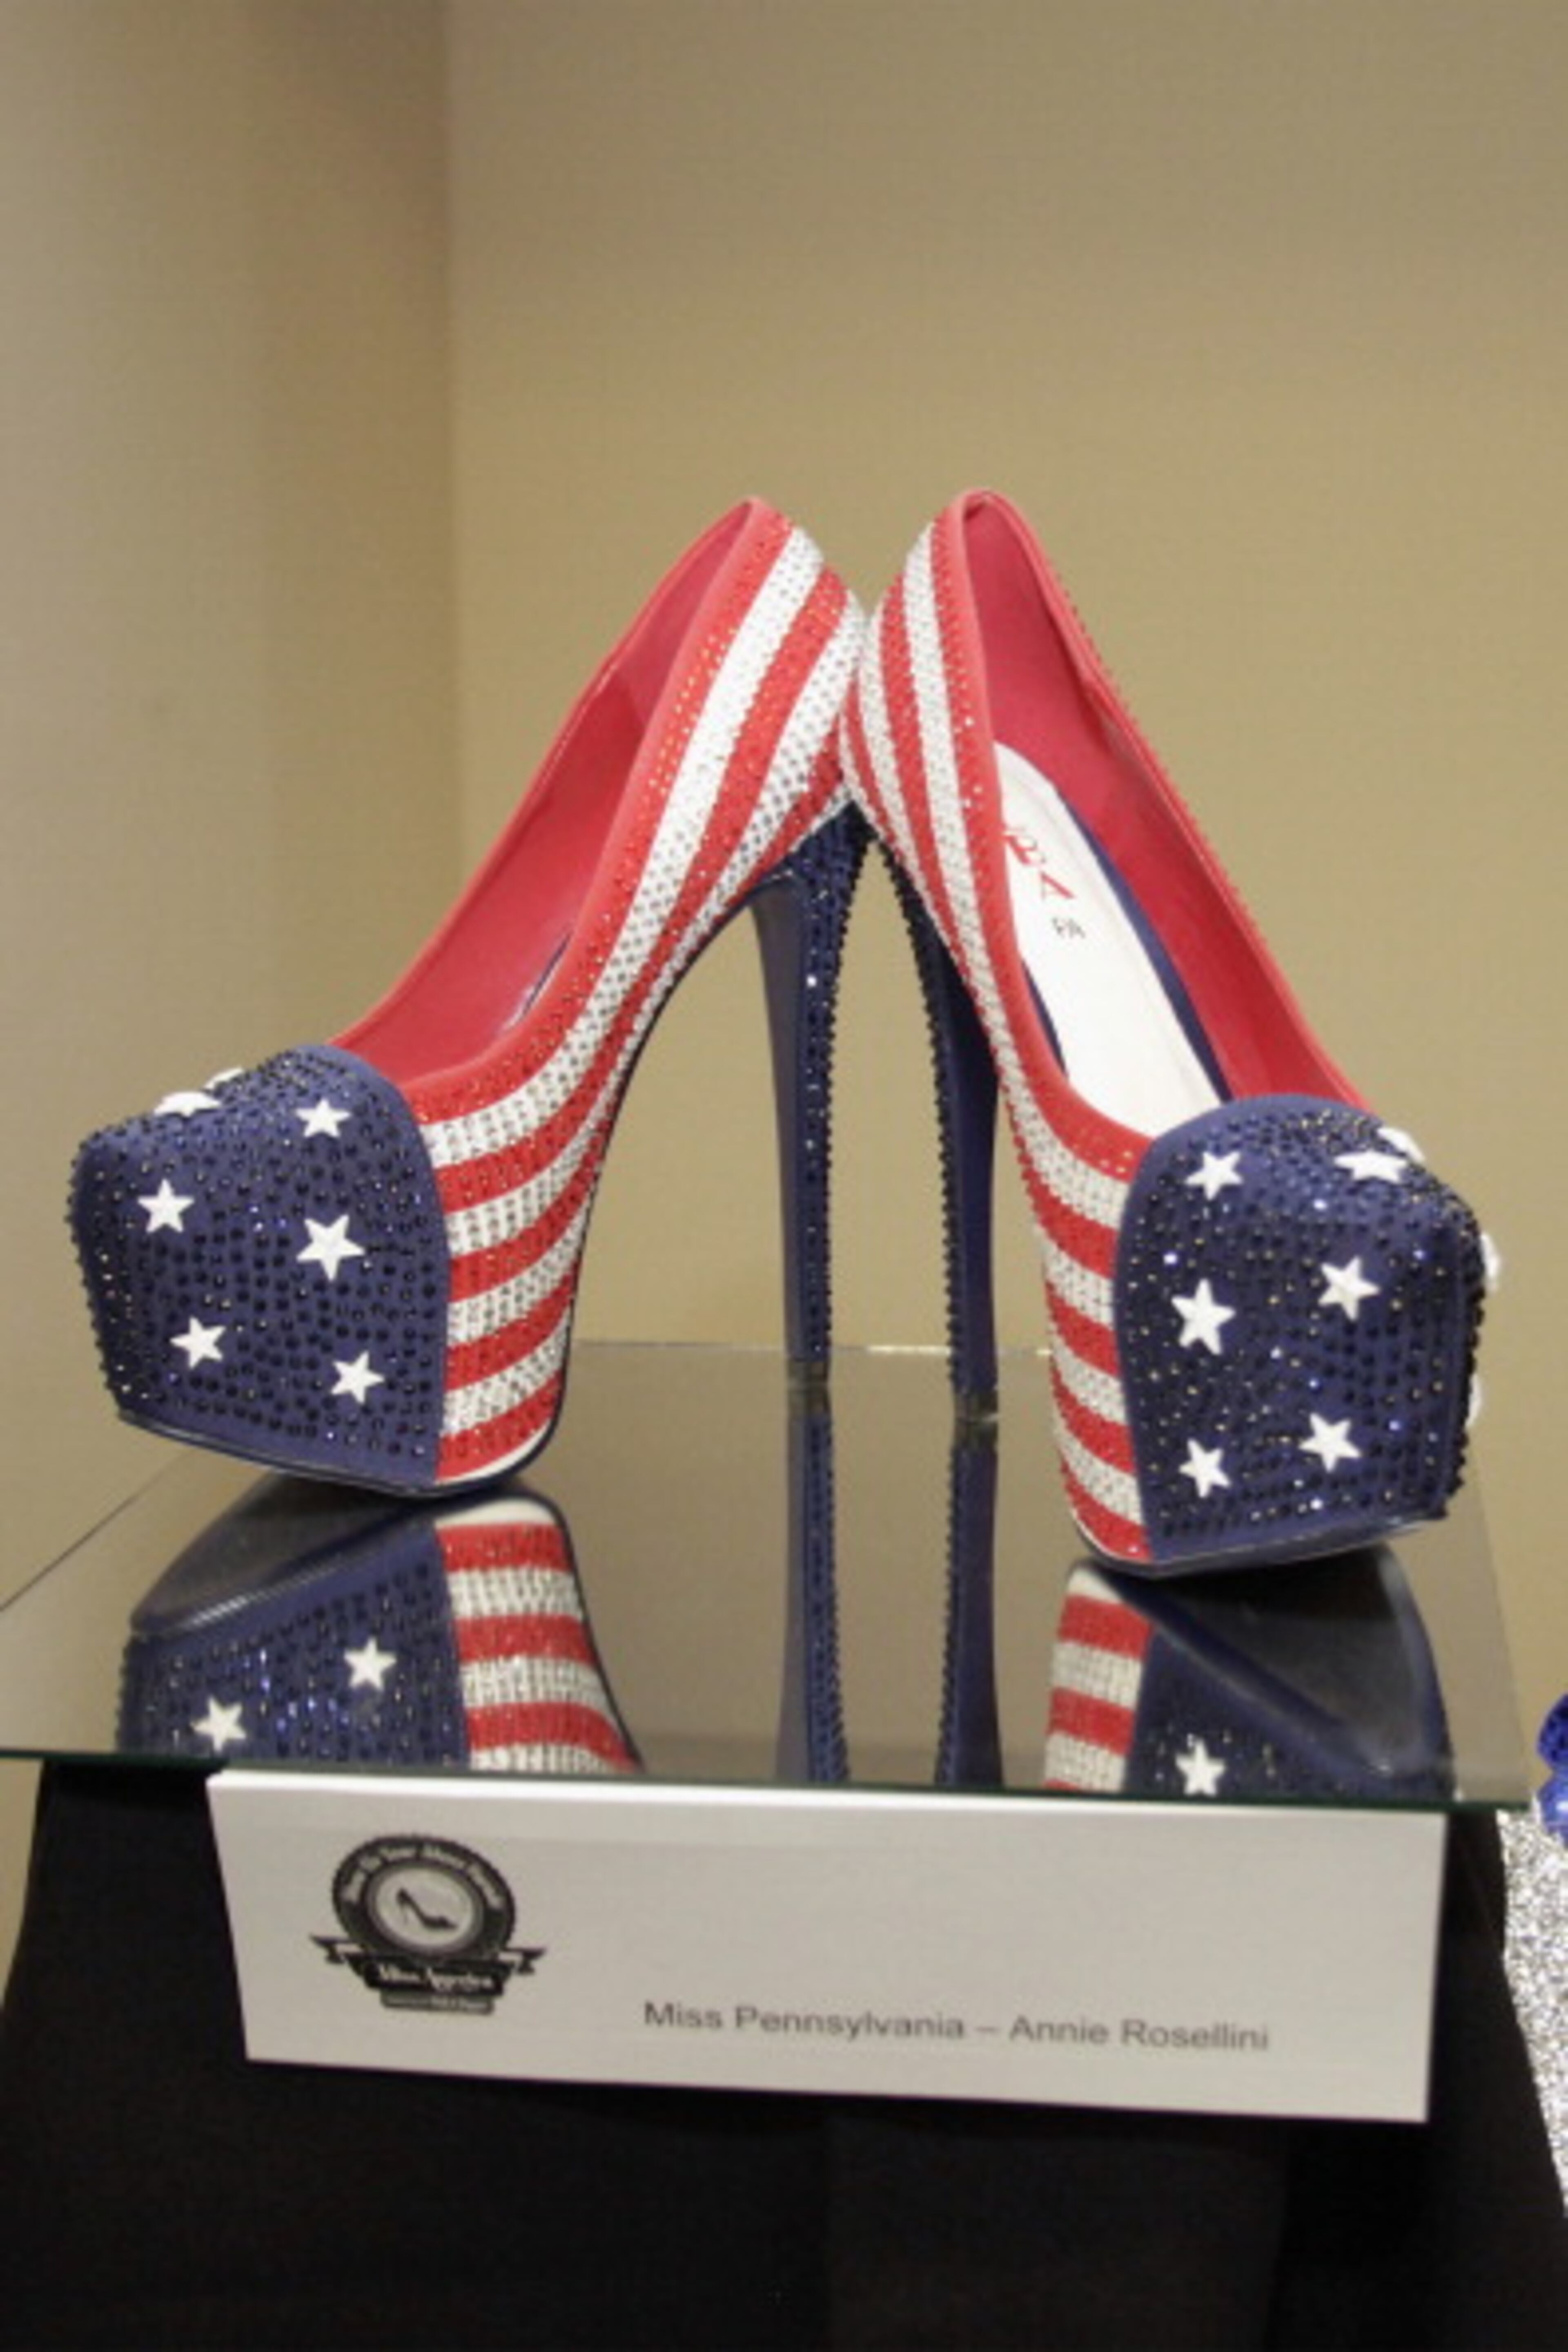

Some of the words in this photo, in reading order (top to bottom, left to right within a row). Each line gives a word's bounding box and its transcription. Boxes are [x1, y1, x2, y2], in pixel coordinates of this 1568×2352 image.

[644, 2001, 723, 2029] Miss
[735, 2005, 965, 2040] Pennsylvania
[1009, 2015, 1109, 2043] Annie
[1122, 2019, 1269, 2049] Rosellini
